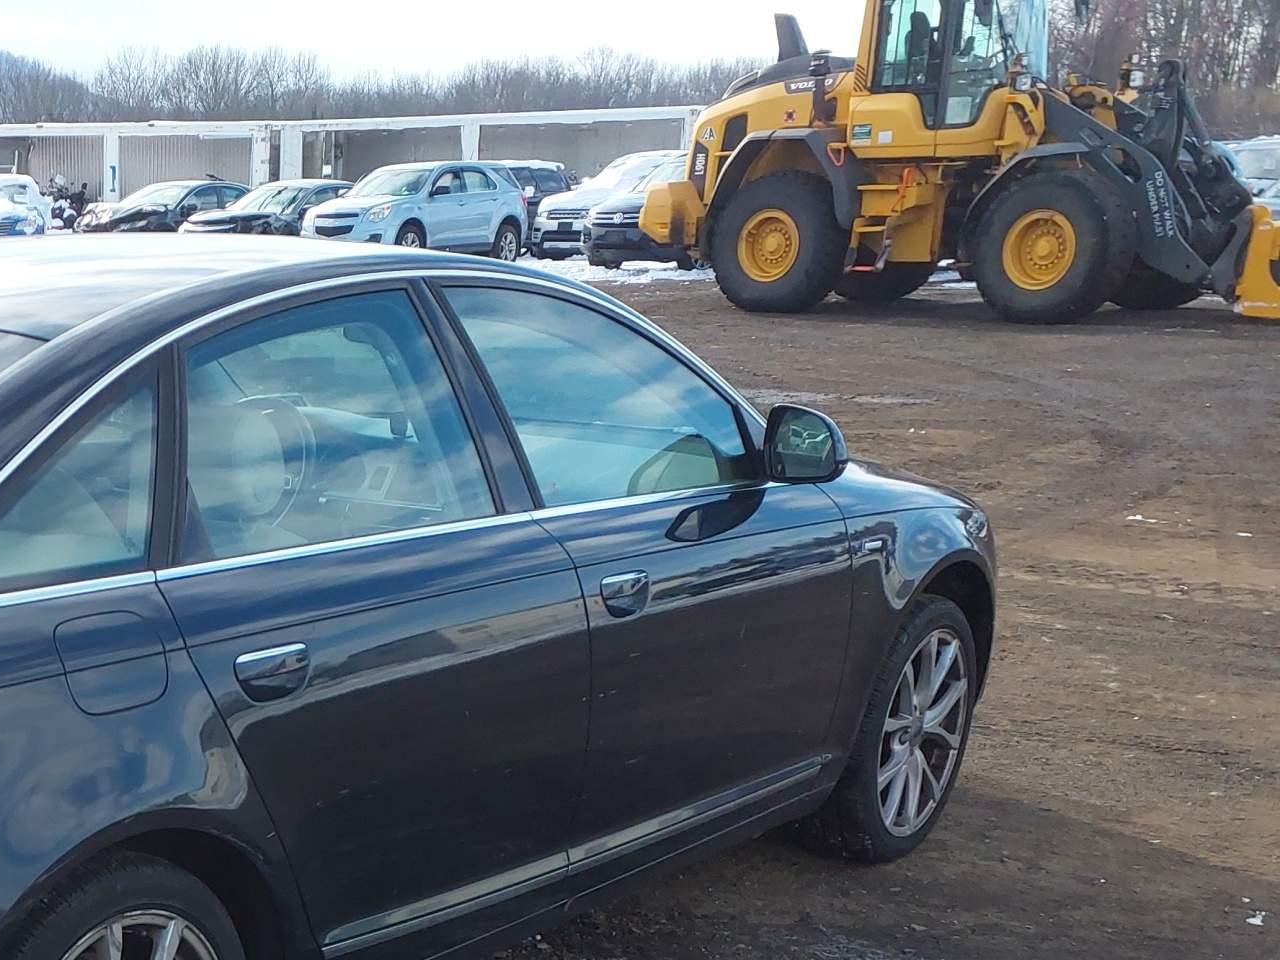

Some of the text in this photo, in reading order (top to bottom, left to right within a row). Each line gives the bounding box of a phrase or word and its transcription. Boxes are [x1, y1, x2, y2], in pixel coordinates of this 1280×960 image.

[790, 79, 833, 90] VOLO
[694, 153, 706, 175] L90H
[1154, 170, 1175, 238] DO NOT WALK
